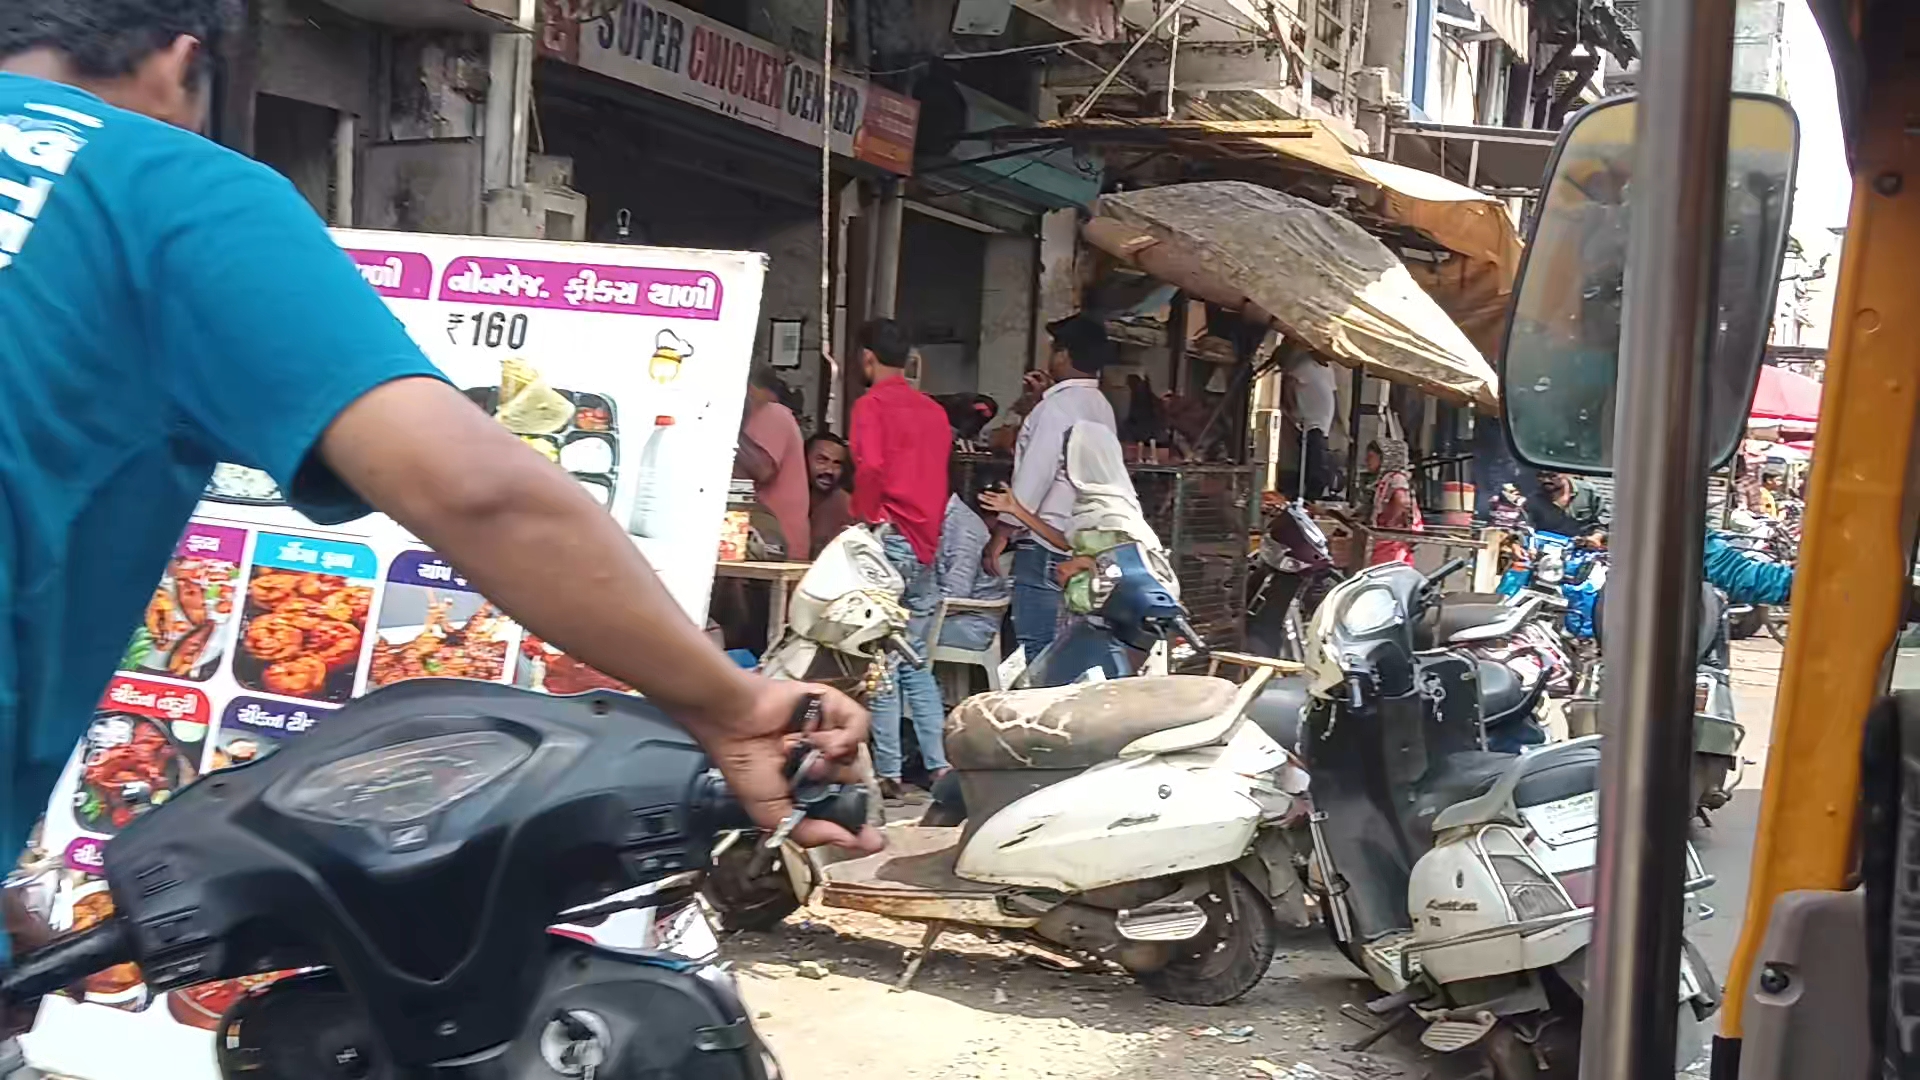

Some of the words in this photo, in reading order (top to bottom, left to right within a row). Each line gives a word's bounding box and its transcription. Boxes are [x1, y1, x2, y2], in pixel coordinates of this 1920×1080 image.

[597, 0, 685, 73] SUPER
[688, 25, 784, 109] CHICKEN
[787, 64, 859, 135] CENTER
